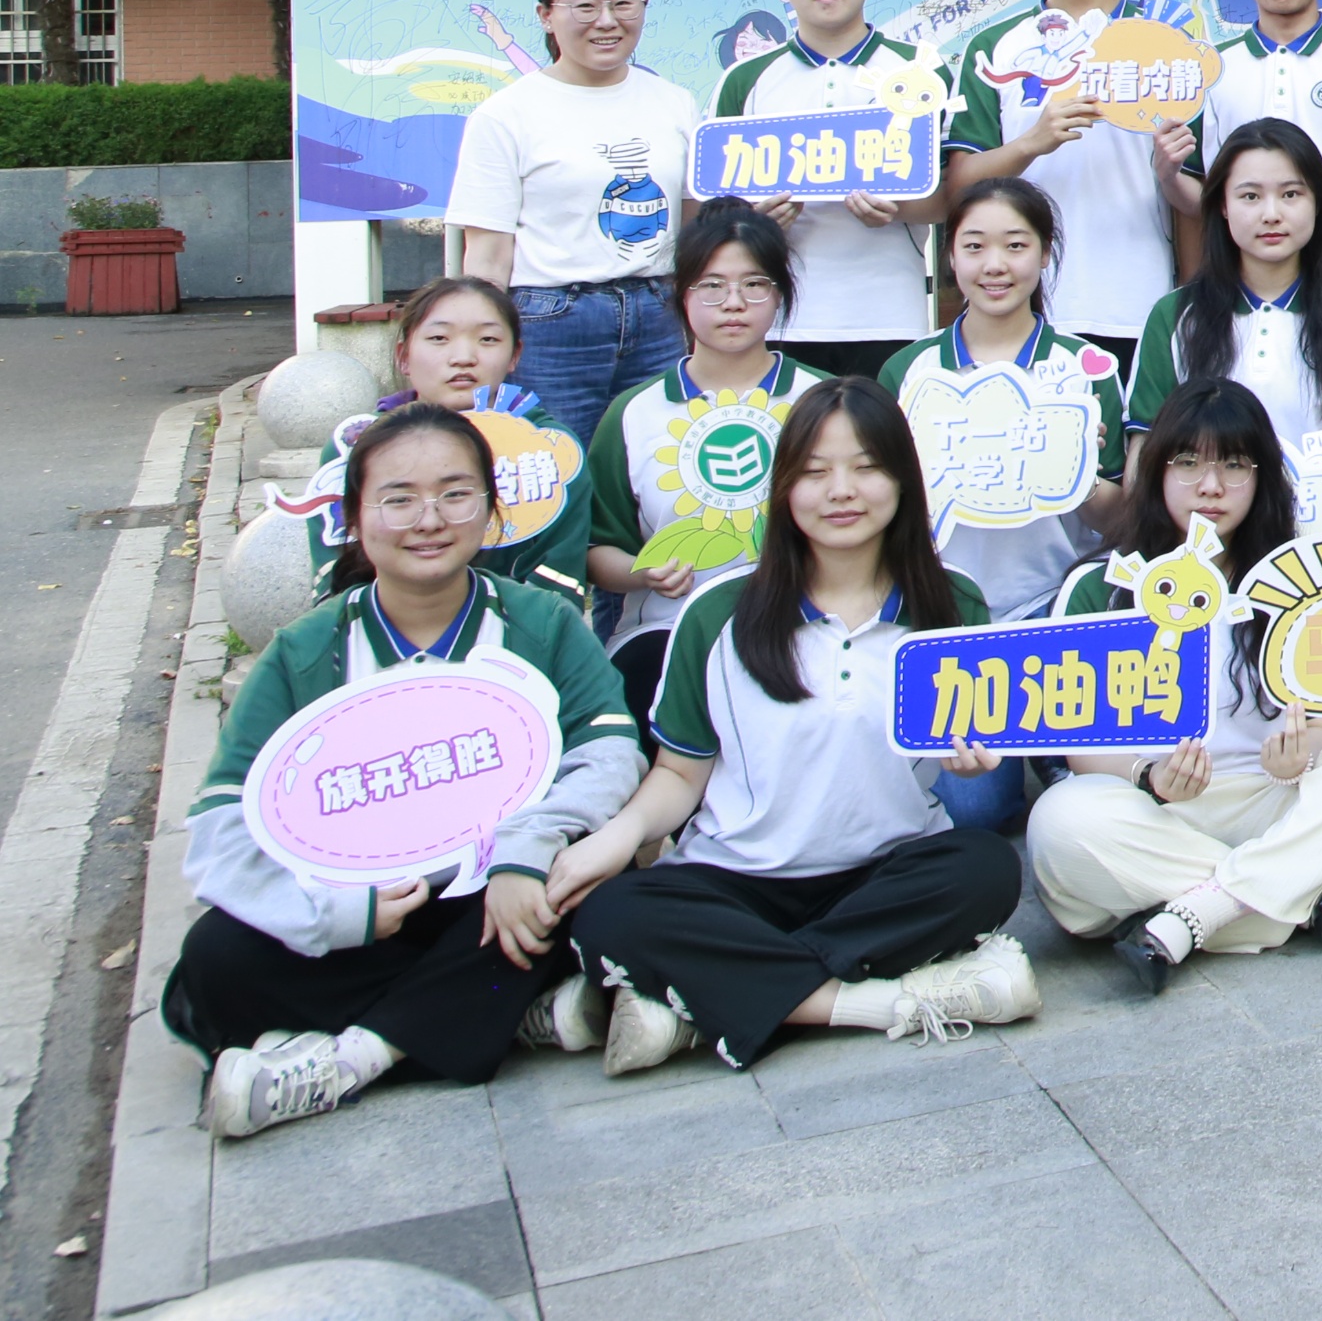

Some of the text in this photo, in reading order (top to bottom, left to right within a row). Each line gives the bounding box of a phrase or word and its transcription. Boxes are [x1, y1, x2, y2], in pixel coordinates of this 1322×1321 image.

[1077, 58, 1203, 103] 沉着冷静
[720, 129, 914, 189] 加油鸭
[933, 417, 1048, 453] 下一站
[494, 449, 559, 507] 冷静
[930, 454, 1026, 492] 大学!
[930, 647, 1184, 739] 加油鸭
[315, 727, 503, 816] 旗开得胜
